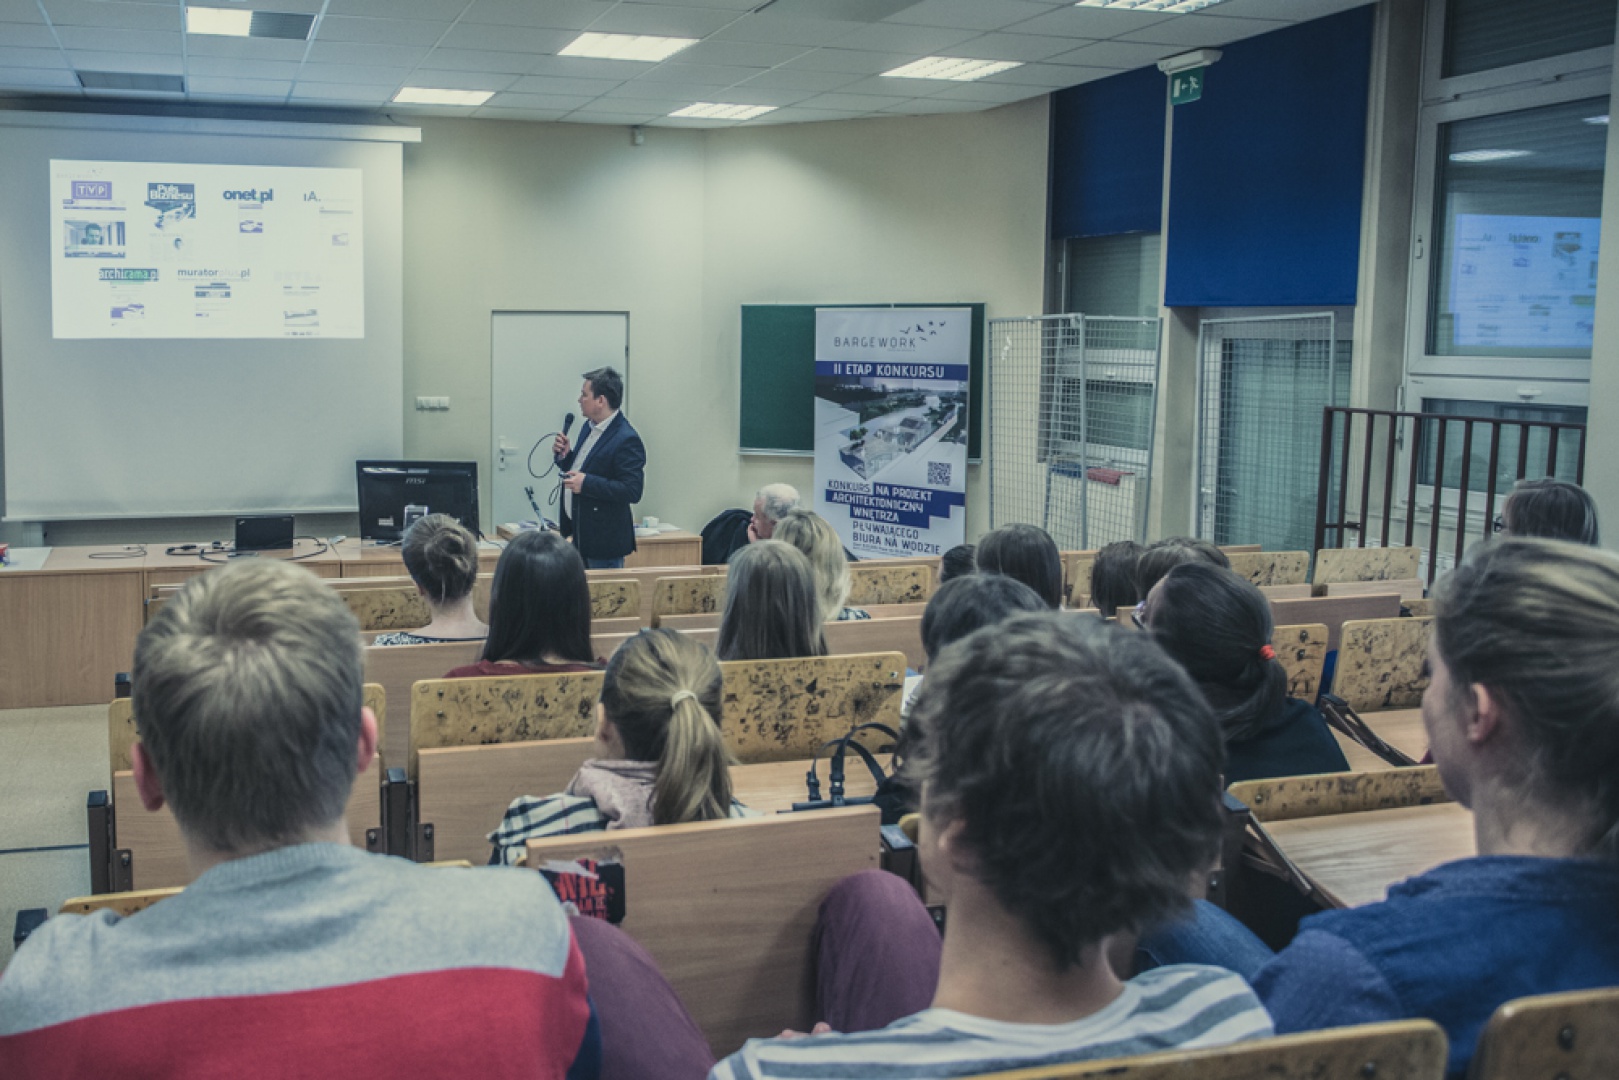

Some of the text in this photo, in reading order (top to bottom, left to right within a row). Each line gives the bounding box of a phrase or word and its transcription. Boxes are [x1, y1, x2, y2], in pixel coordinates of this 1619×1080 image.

[77, 184, 107, 196] TVP
[223, 188, 274, 203] onet.pl
[833, 336, 916, 348] BARGEWORK
[833, 363, 945, 378] II ETAP KONKURSU
[828, 479, 933, 501] KONKURS NA PROJEKT
[832, 492, 924, 513] ARCHITEKTONICZNY
[853, 507, 899, 522] WNĘTRZA
[852, 521, 919, 540] PŁYWAJĄCEGO
[852, 532, 882, 545] BIURA
[884, 536, 898, 548] NA
[902, 540, 941, 555] WODZIE
